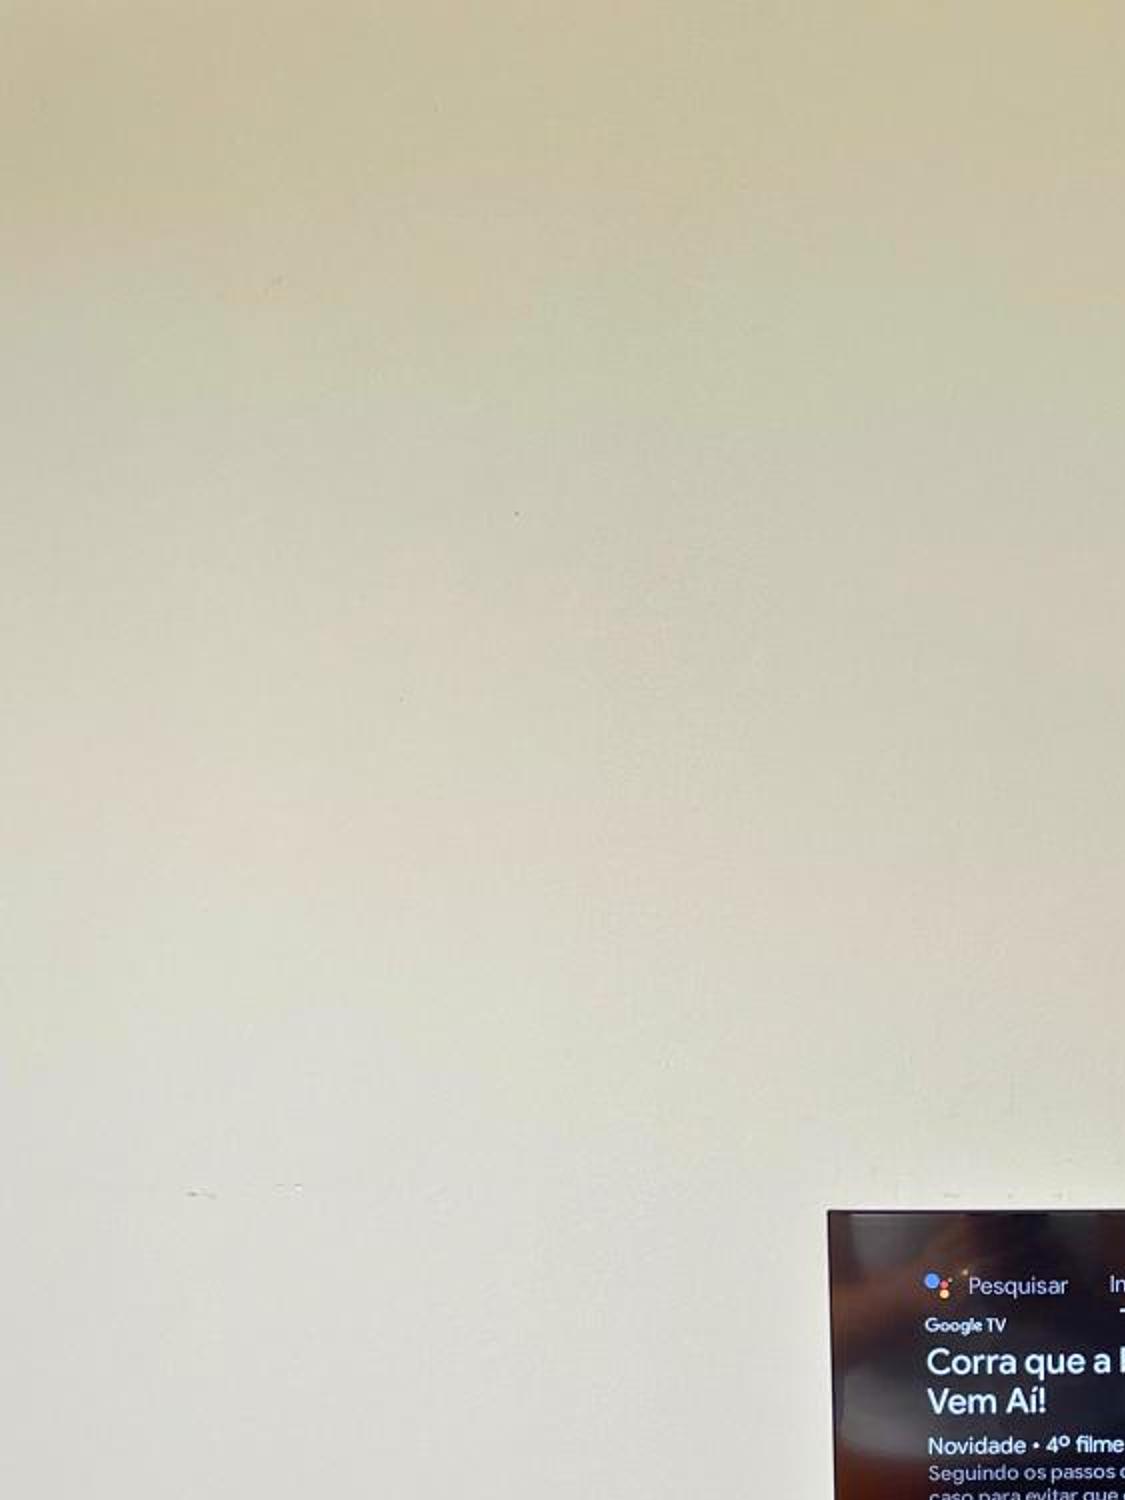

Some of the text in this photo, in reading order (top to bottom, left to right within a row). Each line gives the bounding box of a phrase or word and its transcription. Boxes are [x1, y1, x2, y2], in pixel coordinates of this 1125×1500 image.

[968, 1276, 1069, 1299] Pesquisar
[925, 1317, 1007, 1336] Google TV
[927, 1347, 1017, 1375] Corra
[1024, 1353, 1086, 1381] que
[1093, 1354, 1111, 1374] a
[927, 1386, 1046, 1415] Vem Aí!
[927, 1436, 1027, 1455] Novidade
[1075, 1435, 1125, 1453] filme
[928, 1464, 1019, 1485] Seguindo
[1023, 1467, 1047, 1480] os
[1051, 1466, 1116, 1484] passos
